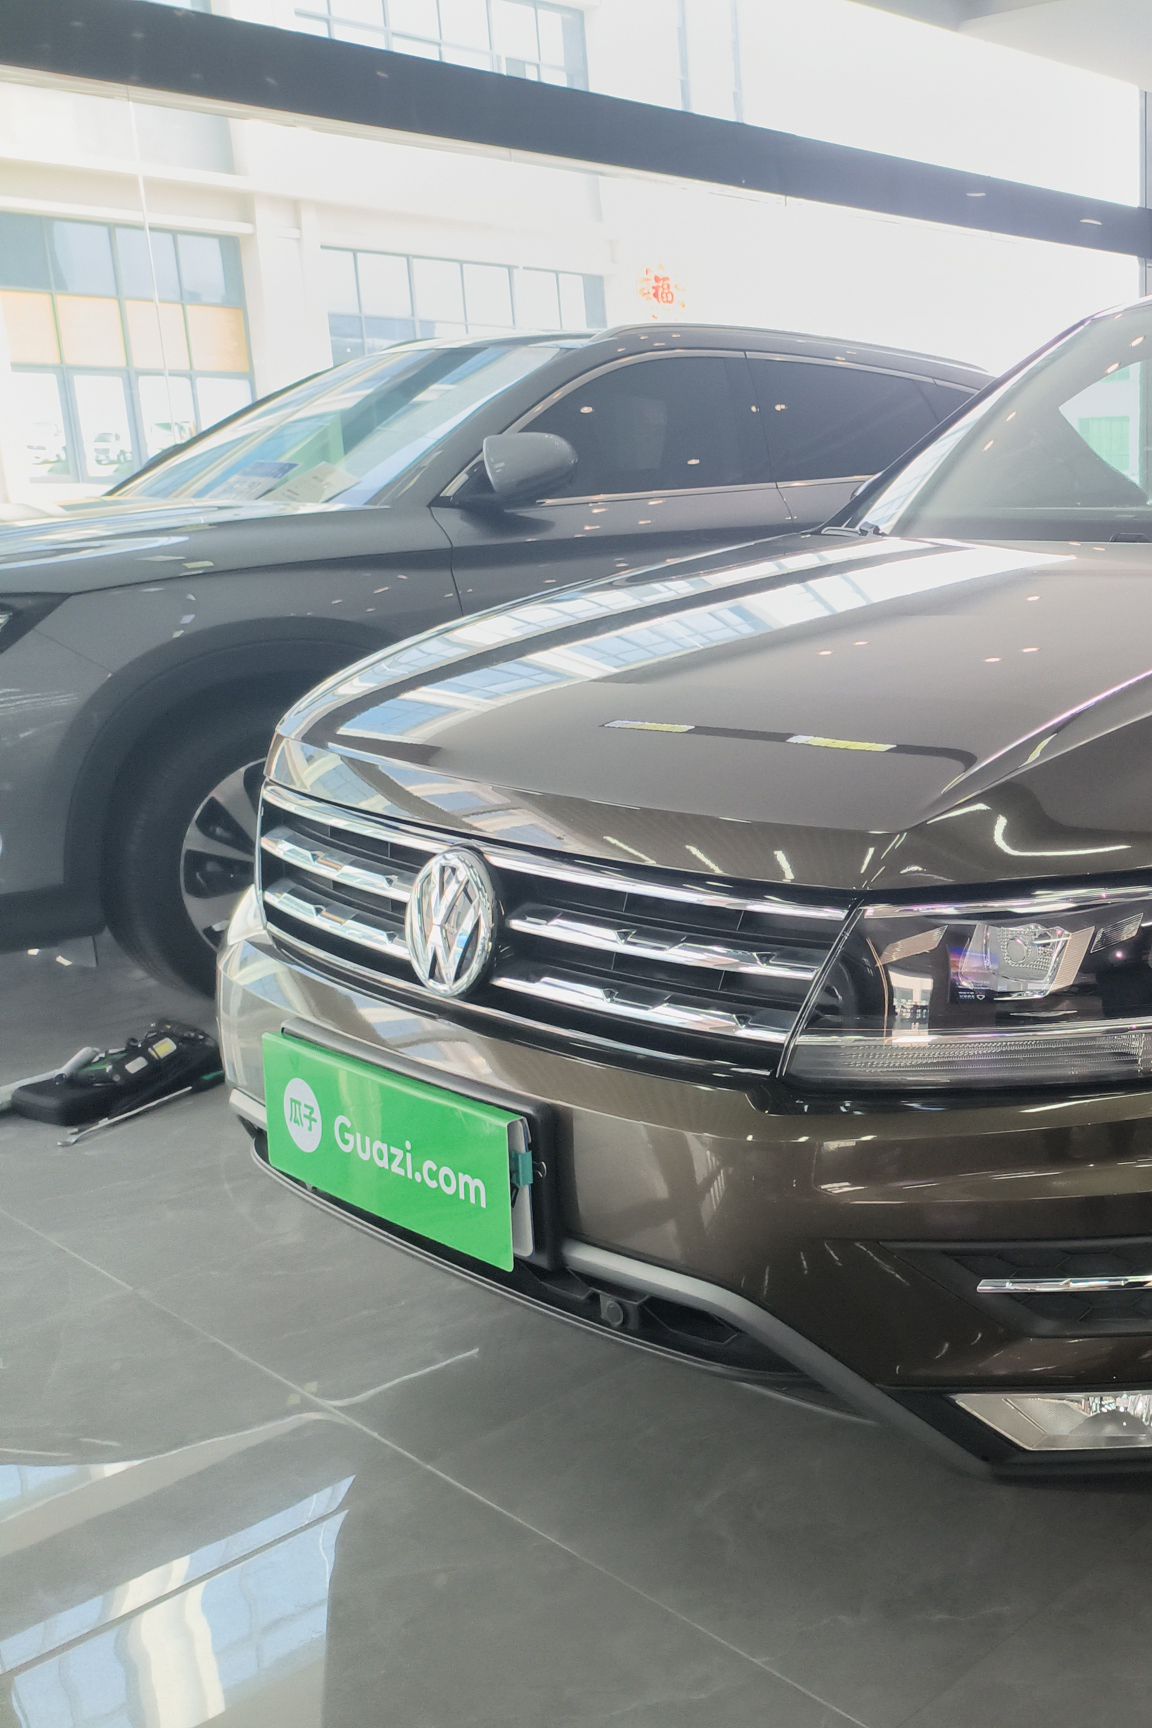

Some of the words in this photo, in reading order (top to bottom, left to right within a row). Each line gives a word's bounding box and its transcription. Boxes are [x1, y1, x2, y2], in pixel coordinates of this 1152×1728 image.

[652, 275, 675, 304] 福
[289, 1097, 318, 1132] 瓜子
[334, 1115, 487, 1208] Guazi.com
